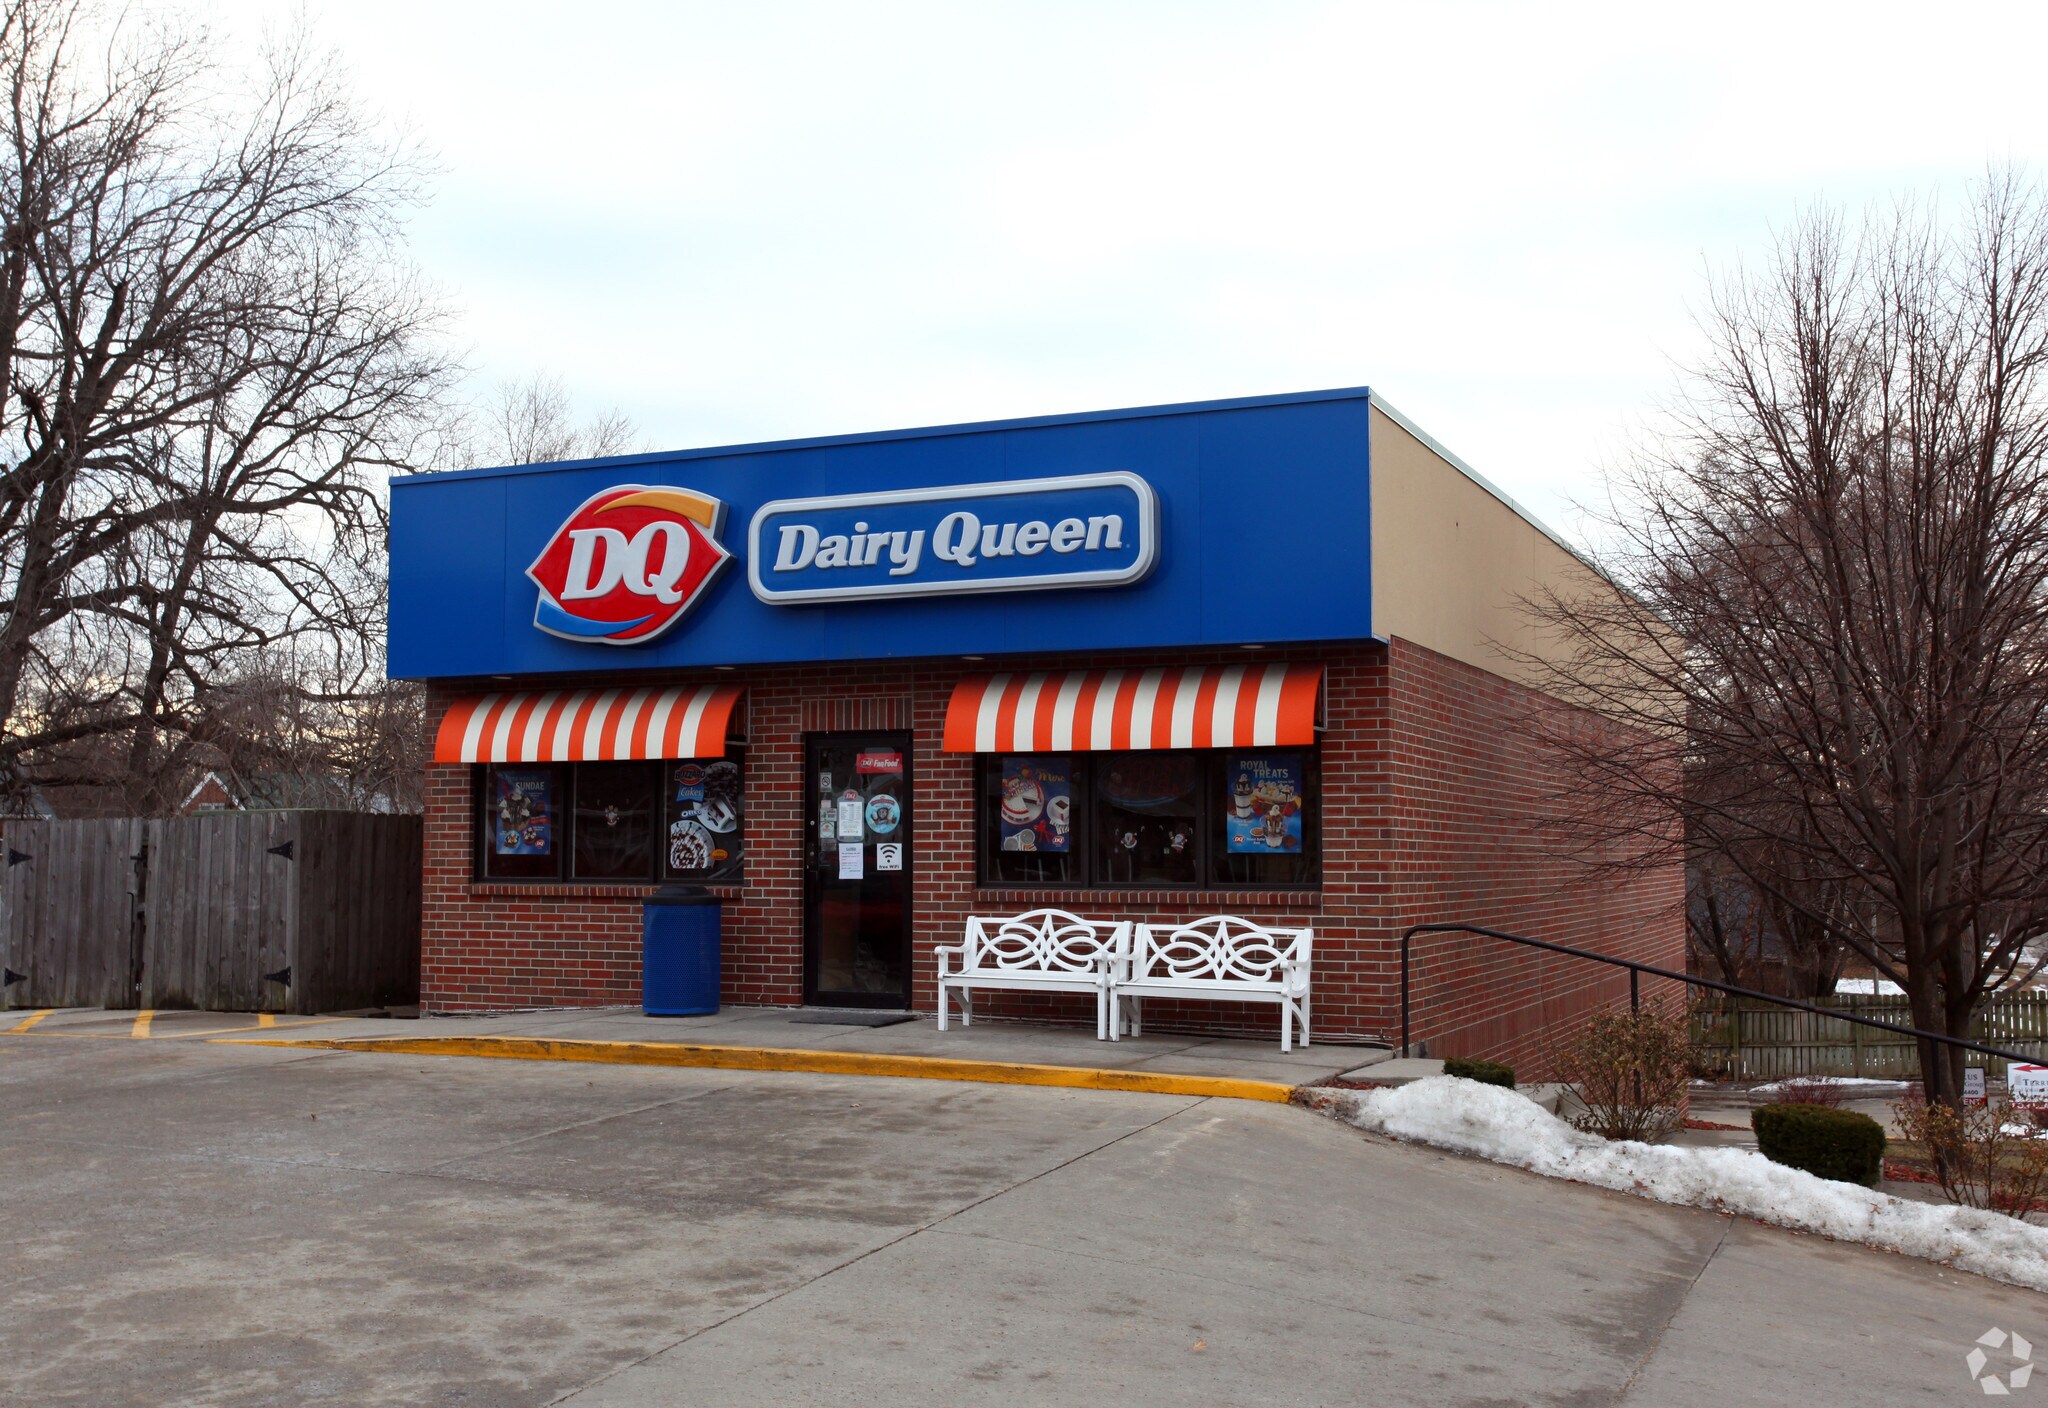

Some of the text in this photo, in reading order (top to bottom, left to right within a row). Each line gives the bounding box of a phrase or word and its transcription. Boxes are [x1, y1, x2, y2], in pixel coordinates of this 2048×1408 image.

[773, 511, 1123, 576] Dairy Queen
[560, 519, 690, 605] DQ
[1240, 760, 1269, 770] ROYAL
[1254, 769, 1289, 778] TREATS
[515, 781, 545, 791] SUNDAE
[681, 787, 702, 797] Cakes
